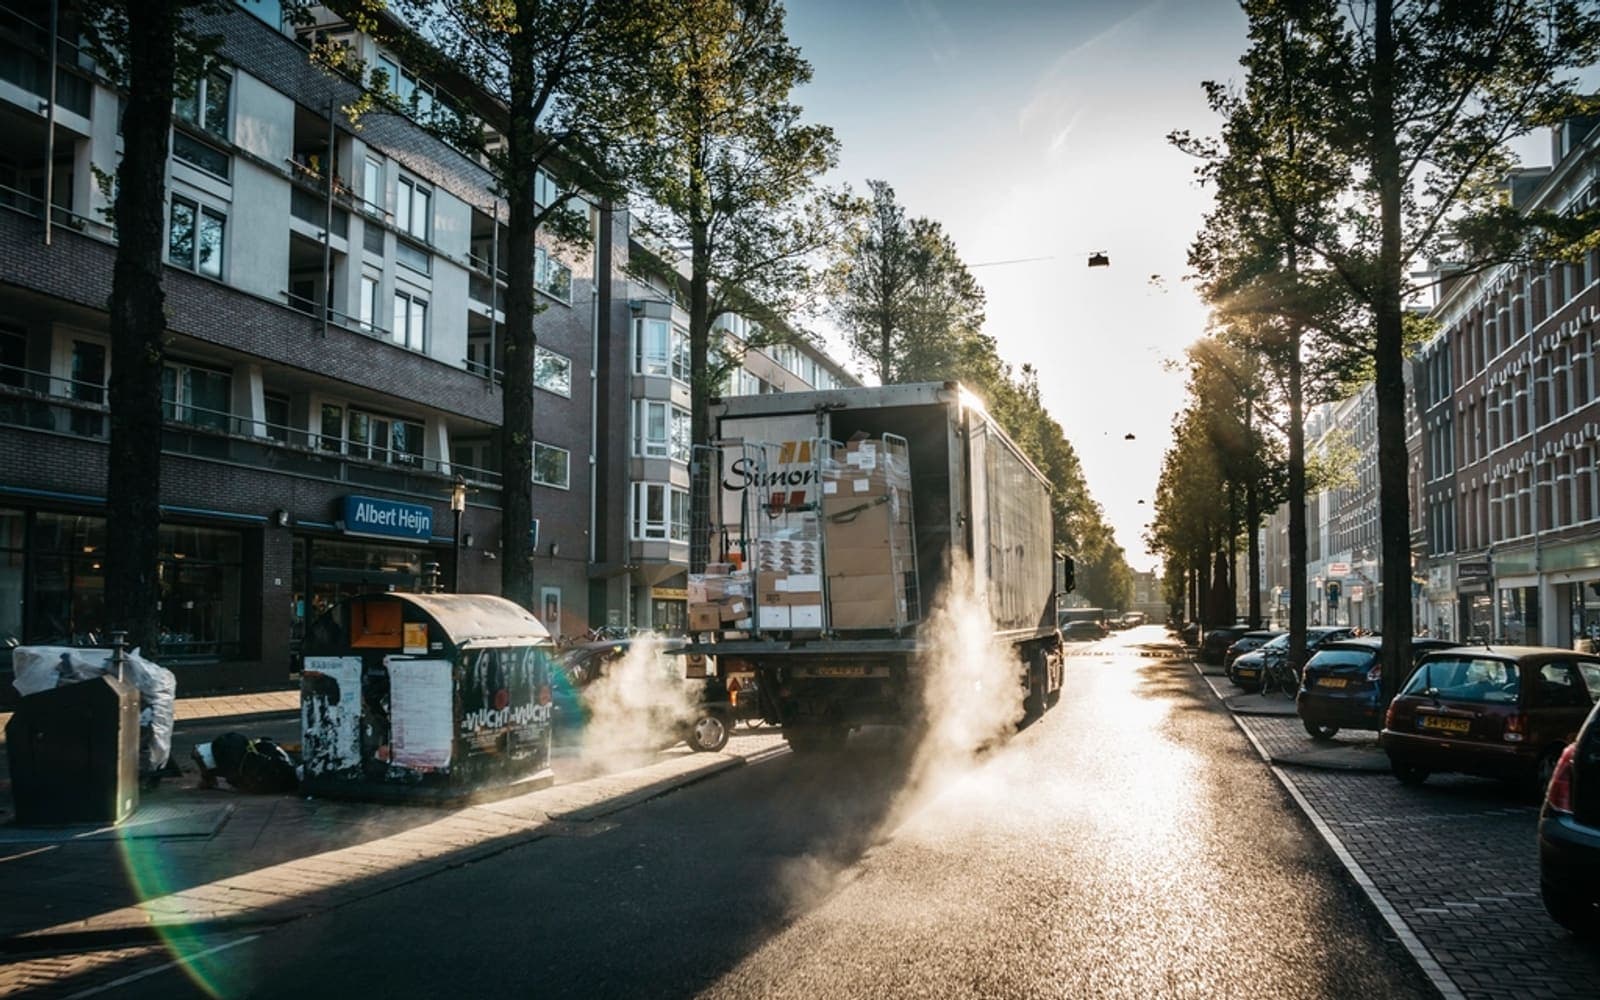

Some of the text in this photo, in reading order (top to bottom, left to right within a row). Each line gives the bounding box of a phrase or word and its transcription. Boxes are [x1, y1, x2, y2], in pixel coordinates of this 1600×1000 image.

[723, 458, 819, 491] Simon
[355, 502, 430, 534] Albert Heijn
[466, 706, 510, 732] VLUCHT
[515, 702, 552, 725] VLUCHT
